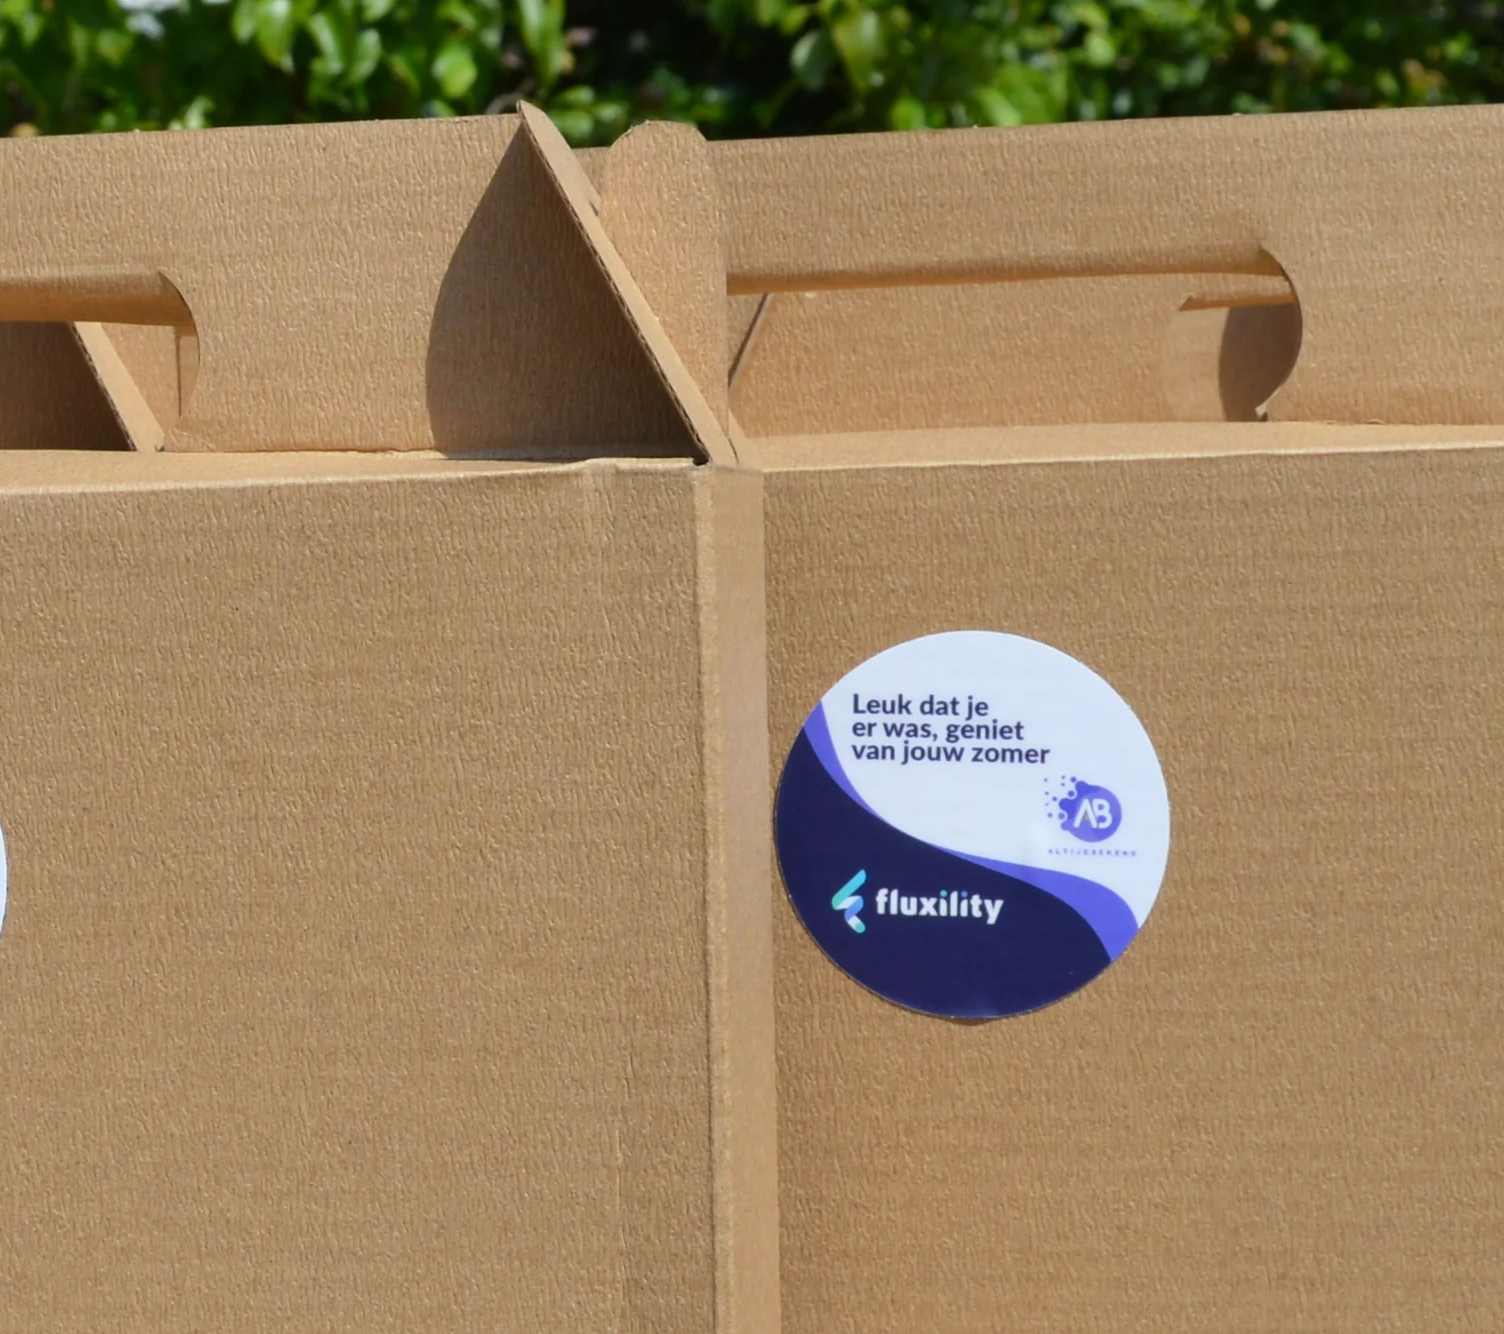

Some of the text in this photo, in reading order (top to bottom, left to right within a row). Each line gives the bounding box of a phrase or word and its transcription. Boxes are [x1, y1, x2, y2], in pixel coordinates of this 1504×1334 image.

[852, 693, 990, 722] Leuk dat je
[851, 718, 1024, 746] er was, geniet
[851, 740, 1051, 765] van jouw zomer
[1073, 798, 1112, 829] AB
[875, 887, 1004, 926] fluxility
